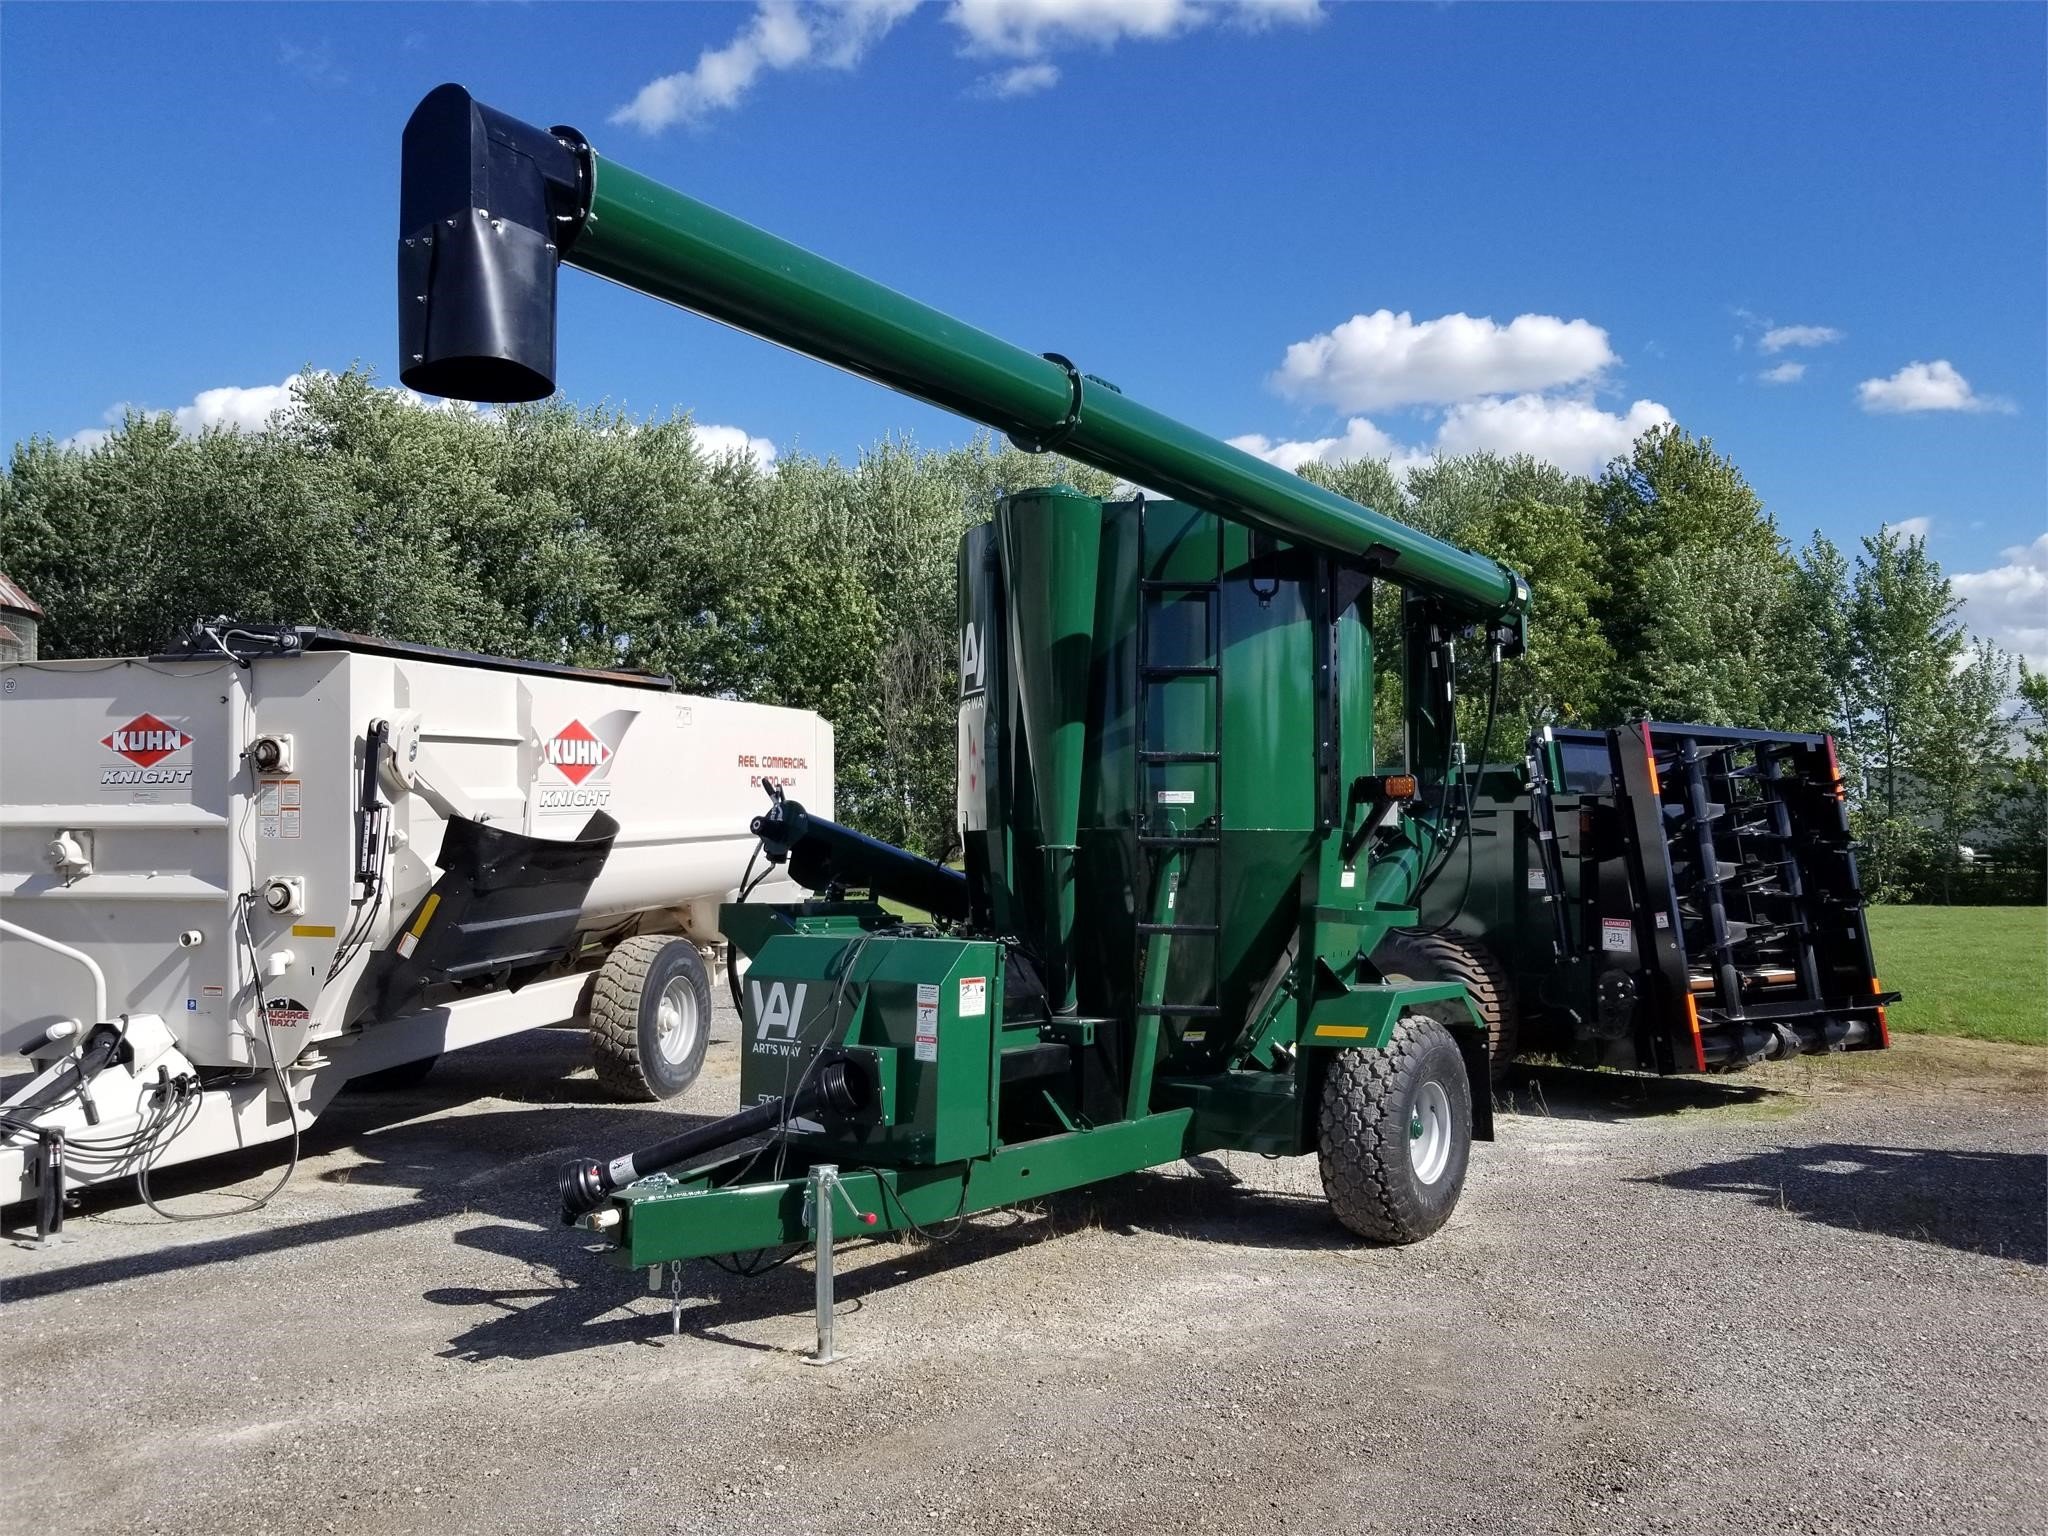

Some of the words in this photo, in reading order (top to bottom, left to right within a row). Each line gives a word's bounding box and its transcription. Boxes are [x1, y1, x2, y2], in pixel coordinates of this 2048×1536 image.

[112, 730, 181, 752] KUHN
[549, 738, 604, 766] KUHN
[738, 754, 760, 768] REEL
[762, 755, 808, 769] COMMERCIAL
[101, 769, 193, 785] KNIGHT
[751, 775, 762, 788] RC
[763, 775, 779, 788] 70
[781, 777, 797, 787] HELIX
[539, 790, 610, 808] KNIGHT
[269, 1019, 297, 1028] MAXX
[752, 1042, 778, 1055] ART'S
[780, 1045, 801, 1057] WAY
